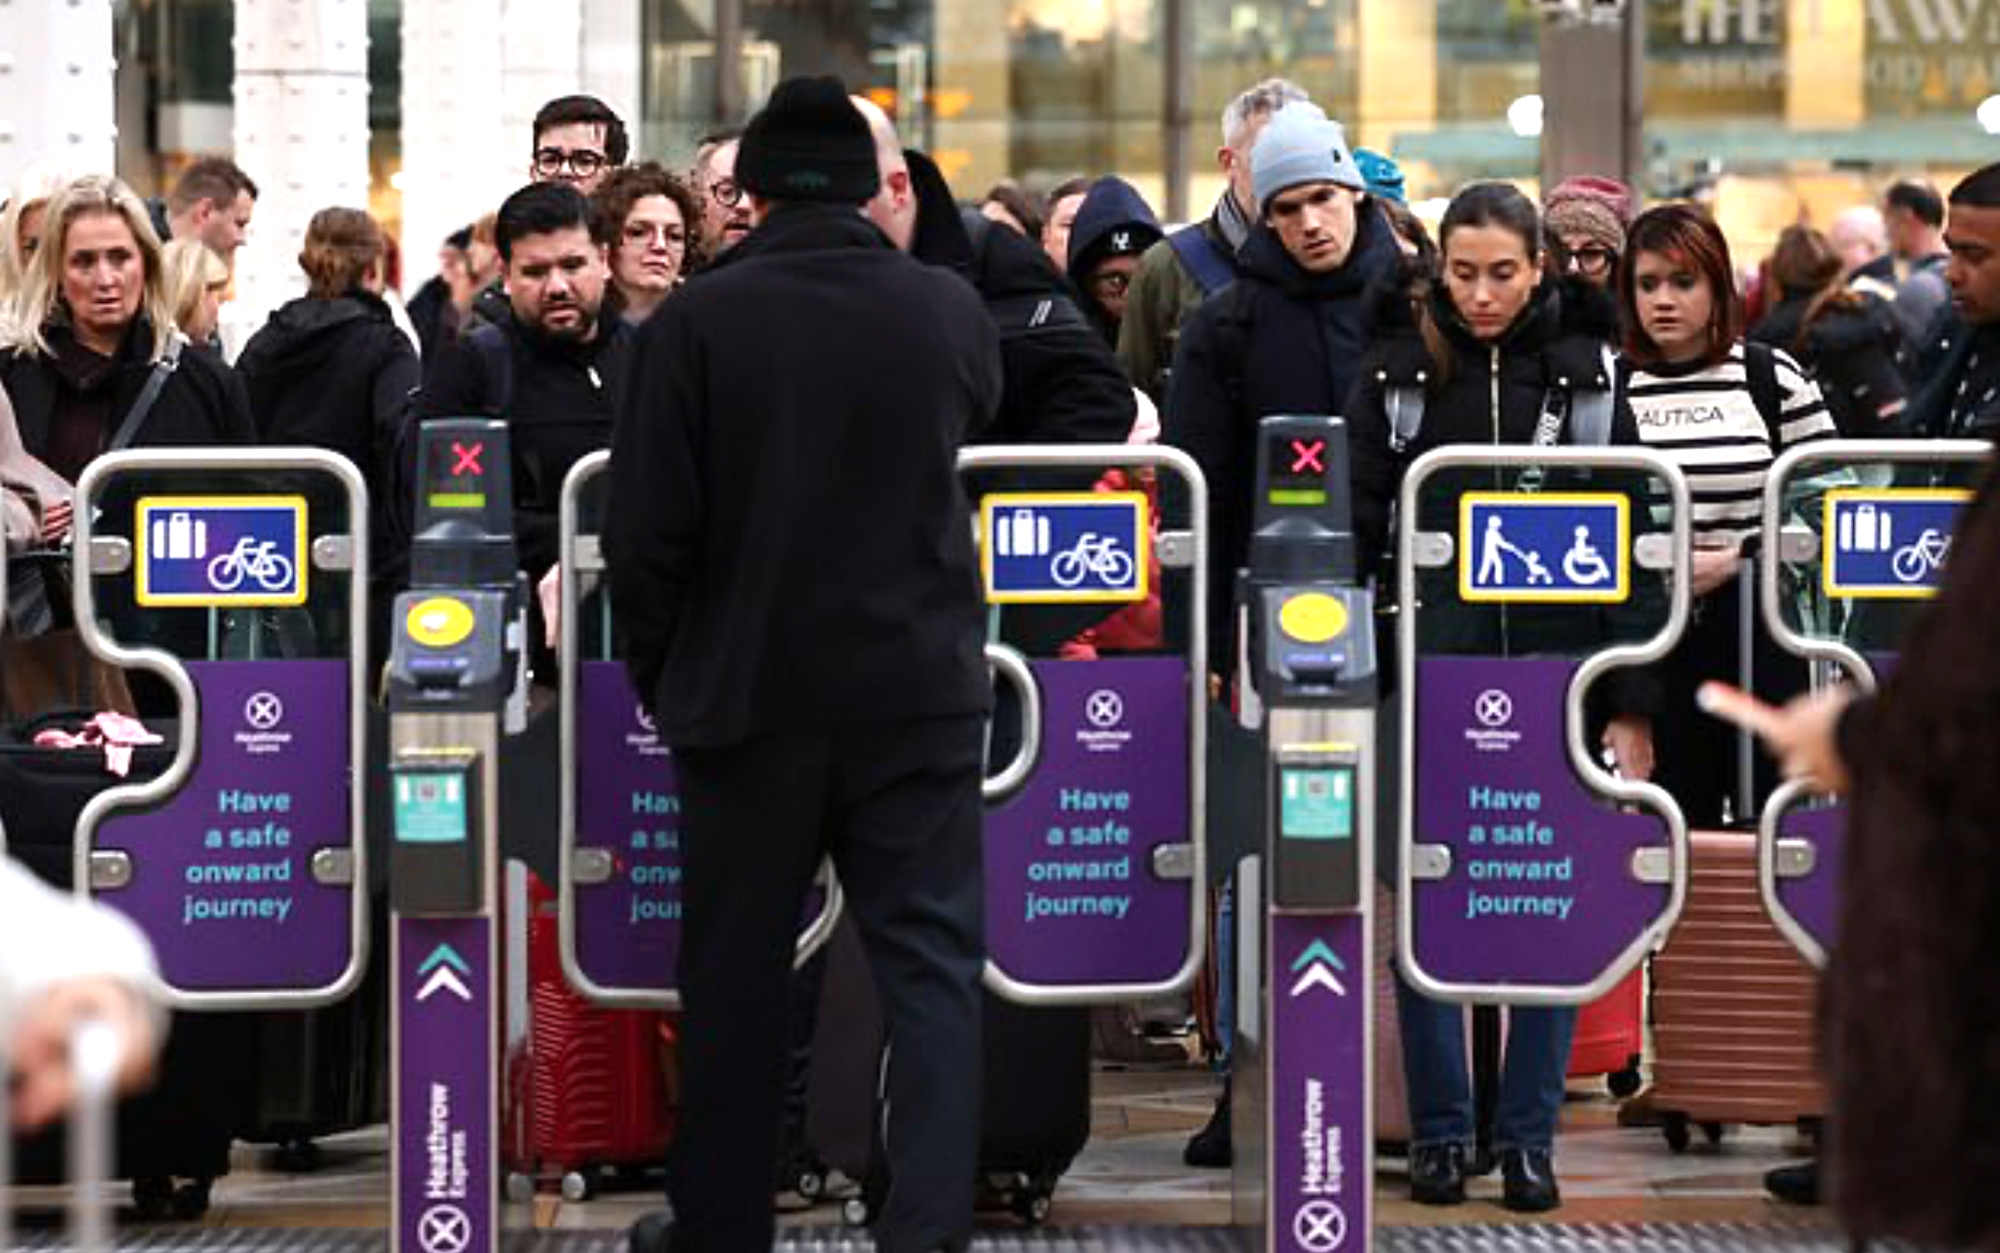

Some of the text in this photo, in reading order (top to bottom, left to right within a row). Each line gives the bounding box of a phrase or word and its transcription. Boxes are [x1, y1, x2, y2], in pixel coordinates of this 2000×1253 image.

[1636, 406, 1725, 426] AUTICA
[218, 790, 290, 812] Have
[1059, 788, 1129, 811] Have
[1469, 786, 1541, 810] Have
[204, 822, 290, 848] a safe
[632, 830, 647, 848] a
[1047, 821, 1129, 846] a safe
[1468, 820, 1553, 844] a safe
[186, 859, 290, 882] onward
[1028, 858, 1129, 881] onward
[1468, 857, 1573, 880] onward
[184, 895, 291, 924] journey
[1025, 893, 1130, 923] journey
[1466, 891, 1573, 922] journey
[426, 1083, 448, 1199] Heathrow
[1301, 1079, 1323, 1194] Heathrow
